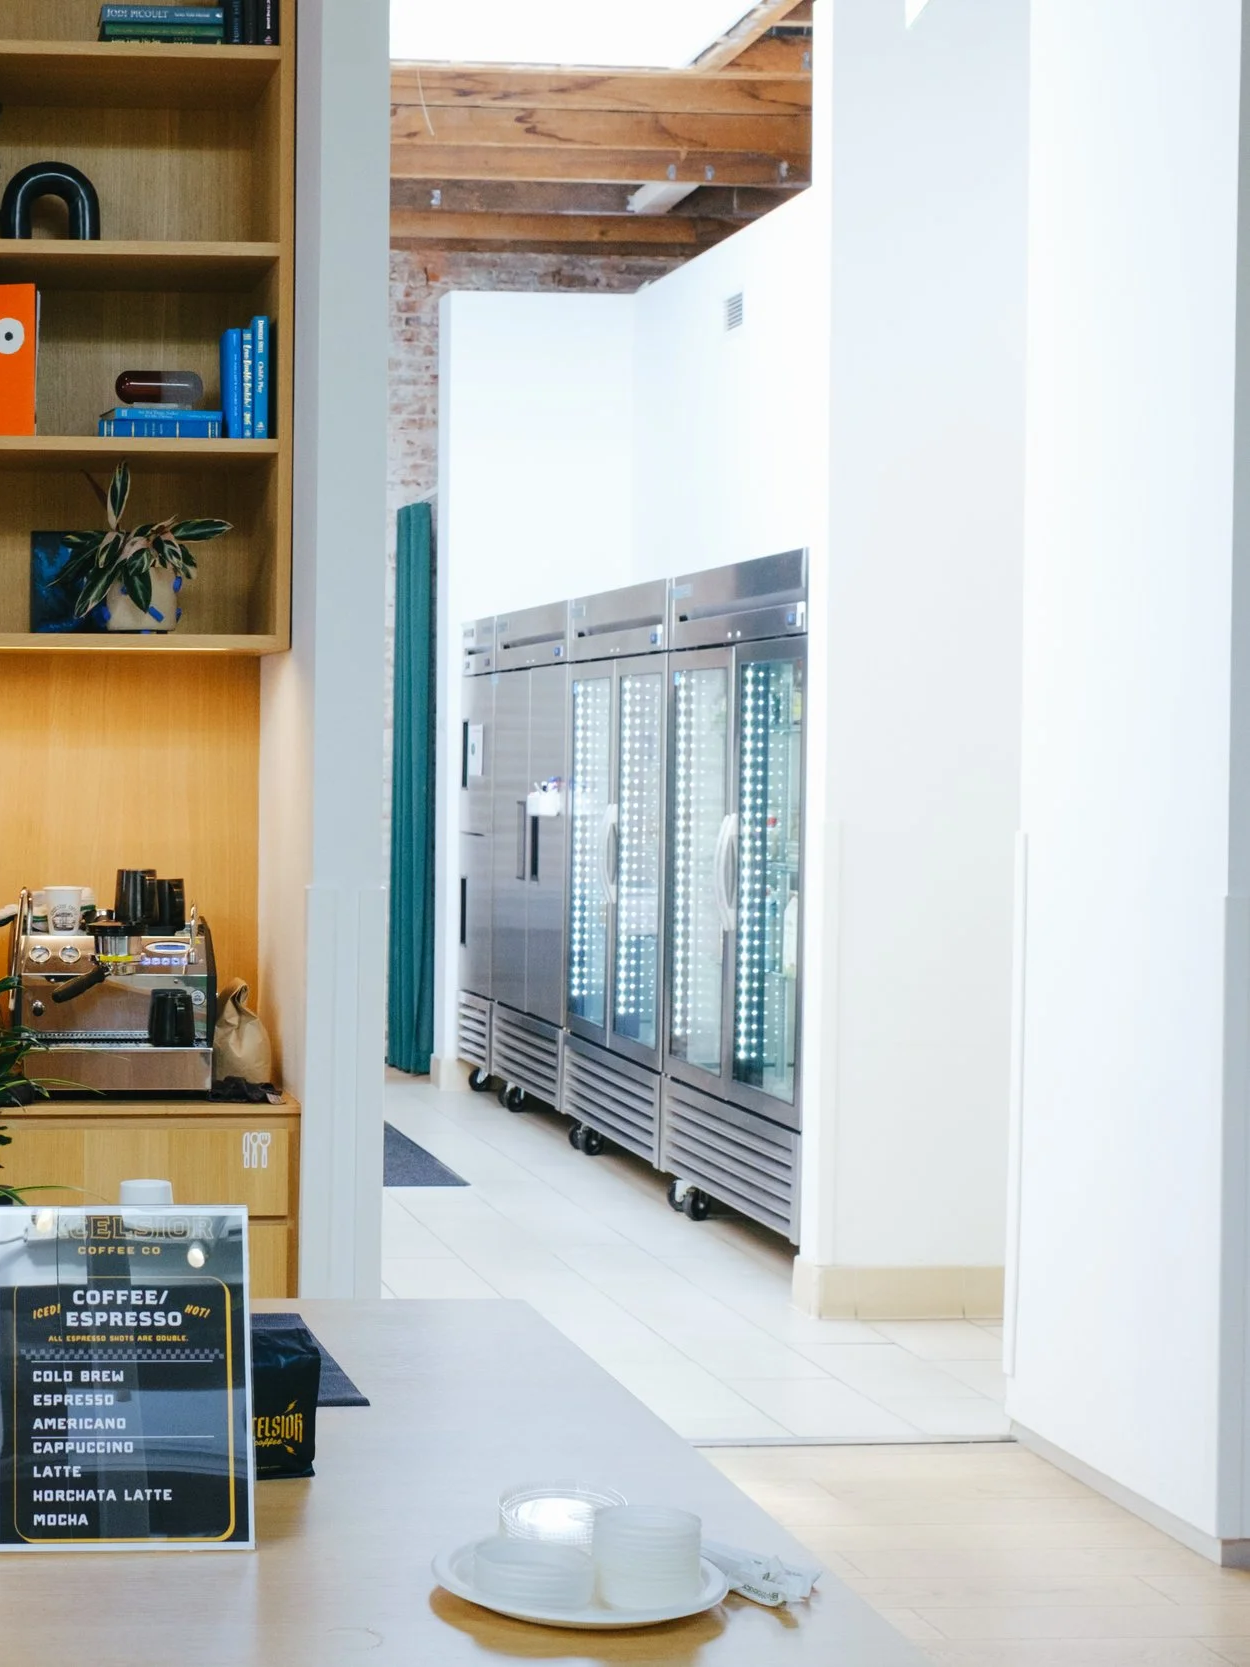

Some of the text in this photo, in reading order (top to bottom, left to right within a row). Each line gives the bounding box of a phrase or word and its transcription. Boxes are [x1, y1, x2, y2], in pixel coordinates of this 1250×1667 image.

[78, 1246, 160, 1255] COFFEE CO
[72, 1290, 168, 1305] COFFEE/
[32, 1304, 61, 1320] ICED!
[185, 1304, 211, 1318] HOT!
[66, 1312, 182, 1327] ESPRESSO
[33, 1371, 124, 1382] COLD BREW
[33, 1394, 114, 1406] ESPRESSO
[33, 1418, 126, 1430] AMERICANO
[33, 1442, 134, 1454] CAPPUCCINO
[33, 1466, 81, 1478] LATTE
[33, 1489, 172, 1502] HORCHATA LATTE
[33, 1513, 88, 1526] MOCHA
